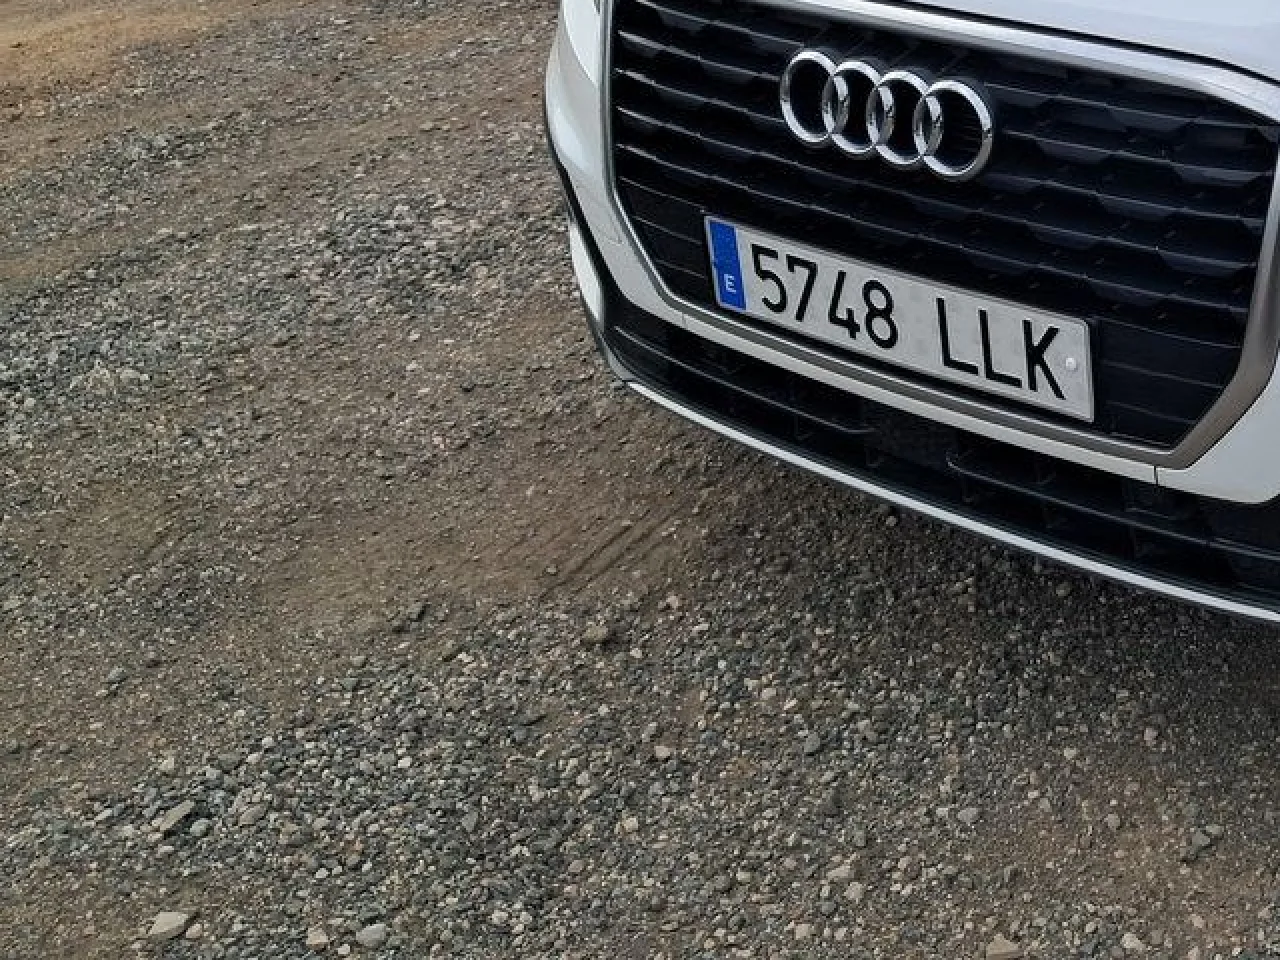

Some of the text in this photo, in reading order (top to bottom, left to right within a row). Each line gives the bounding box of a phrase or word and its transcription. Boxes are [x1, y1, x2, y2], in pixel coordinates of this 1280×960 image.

[724, 273, 737, 293] E
[751, 243, 1067, 401] 5748 LLK
